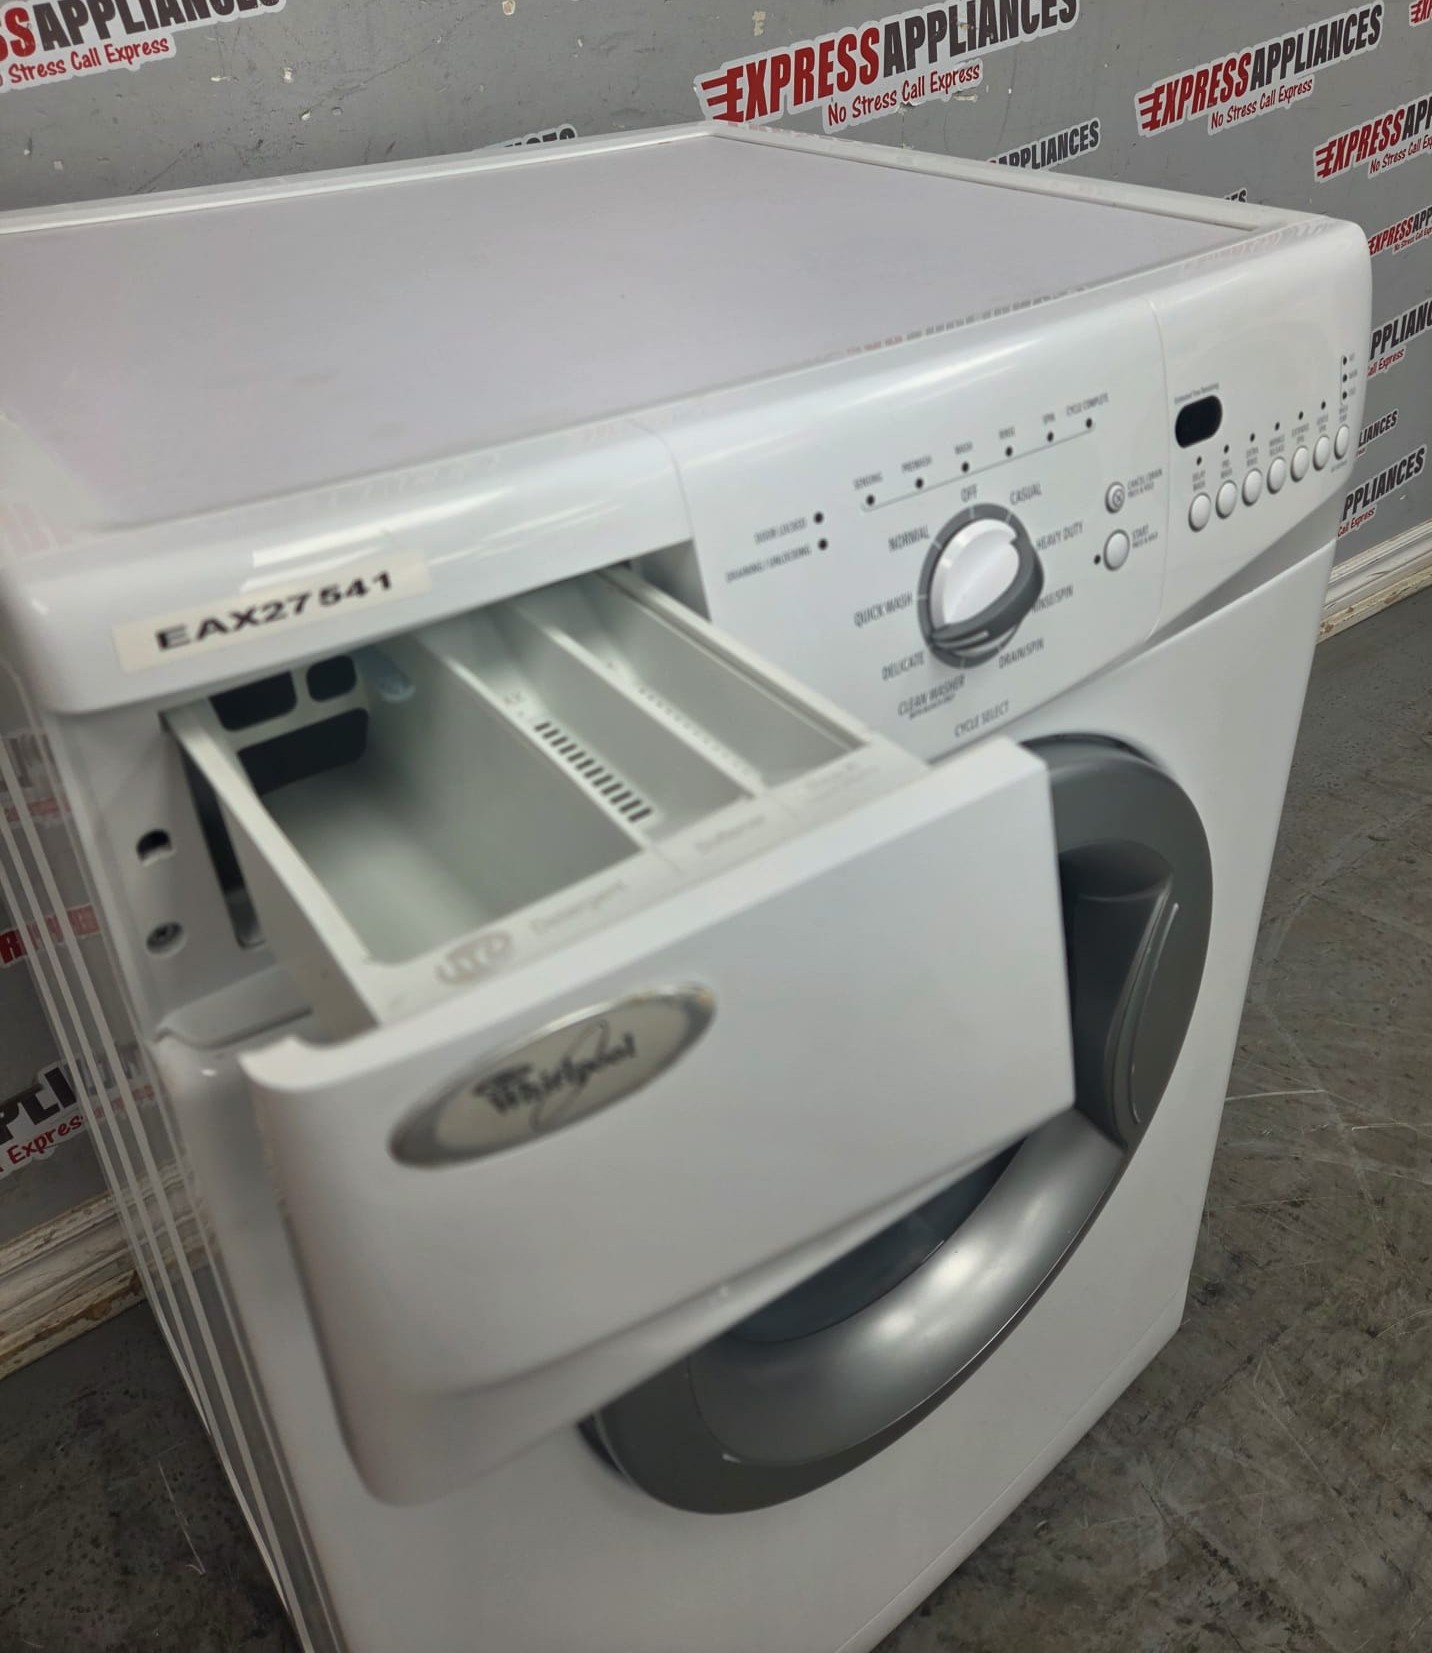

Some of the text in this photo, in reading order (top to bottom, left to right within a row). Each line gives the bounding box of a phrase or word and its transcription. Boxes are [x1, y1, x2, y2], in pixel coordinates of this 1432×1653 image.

[8, 59, 66, 83] Stress
[70, 47, 101, 70] Call
[104, 38, 169, 64] Express
[828, 64, 980, 126] No Stress Call Express
[1211, 79, 1313, 129] No Stress Call Express
[1370, 159, 1380, 174] No
[1382, 149, 1406, 168] Stress
[1408, 137, 1421, 155] Call
[961, 484, 978, 502] OFF
[1010, 483, 1042, 505] CASUAL
[155, 570, 392, 651] EAX27541
[853, 591, 913, 629] QUICK WASH
